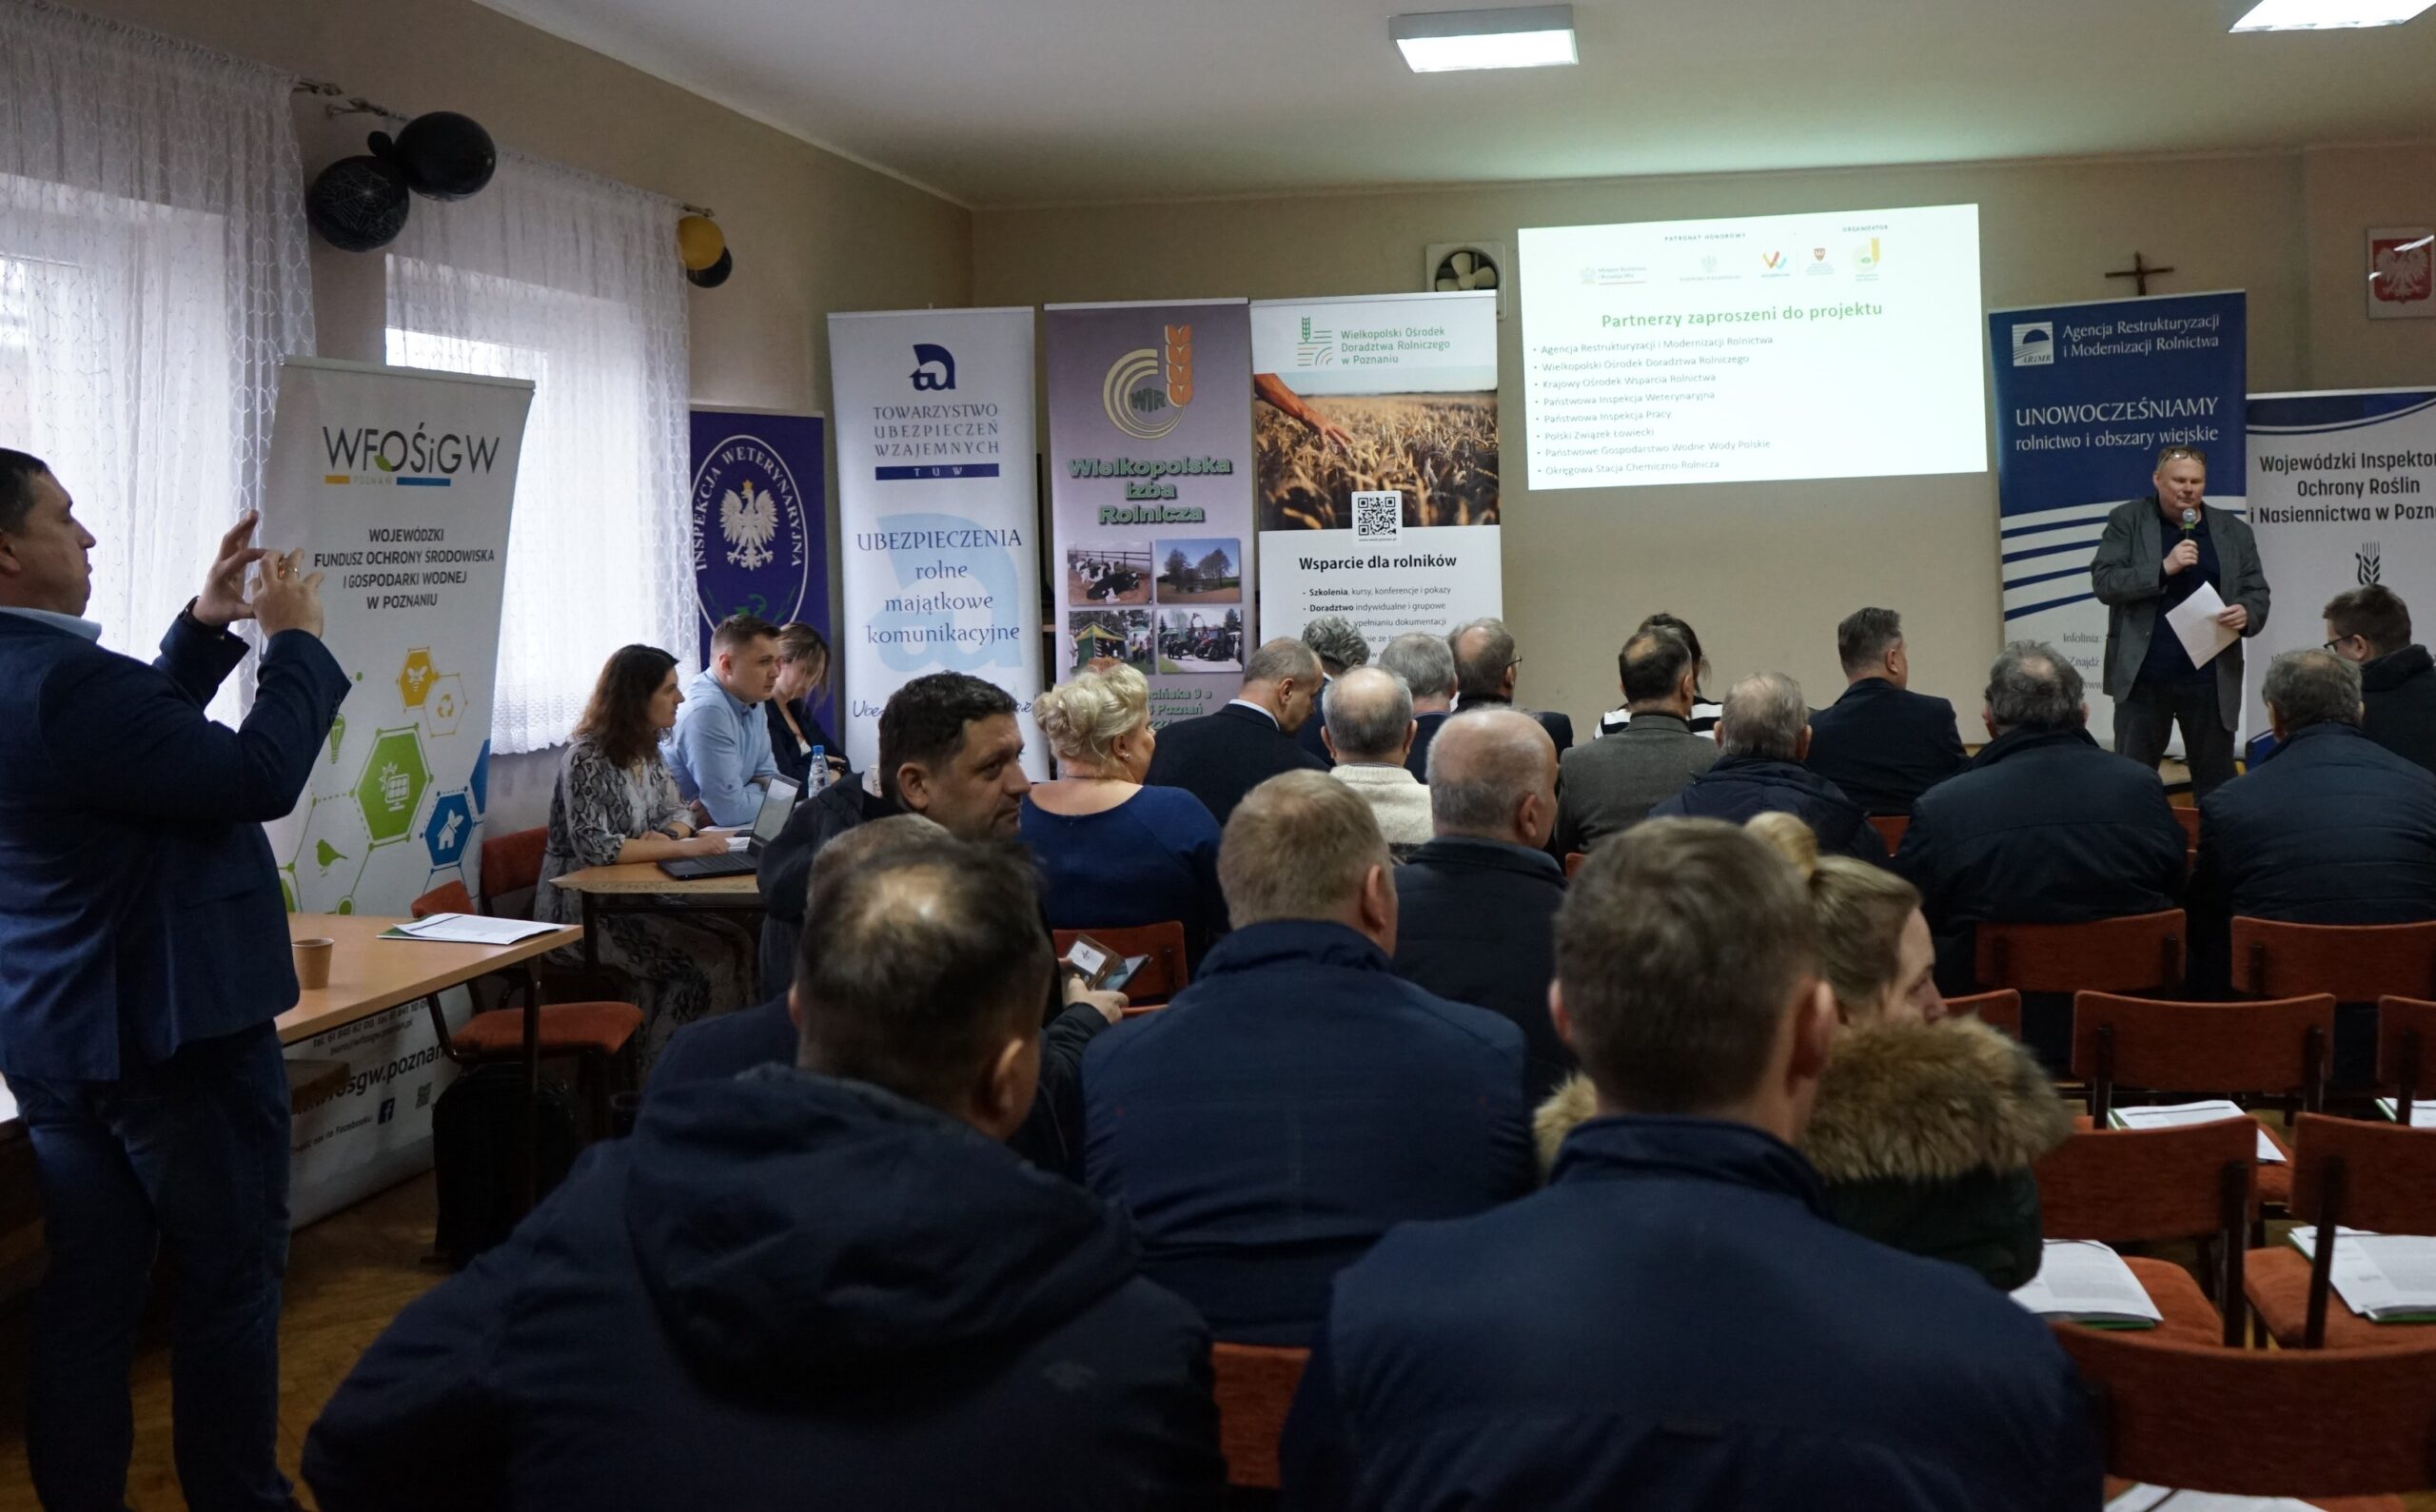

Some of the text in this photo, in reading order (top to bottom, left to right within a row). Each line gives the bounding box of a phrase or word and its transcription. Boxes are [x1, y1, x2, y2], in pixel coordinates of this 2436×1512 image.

[1602, 302, 1882, 330] Partnerzy zaproszeni do projektu
[1341, 327, 1444, 342] Wielkopolski Ośrodek
[2063, 314, 2220, 343] Agencja Restrukturyzacji
[1342, 339, 1450, 352] Doradztwa Rolniczego
[1542, 345, 1578, 356] Agencja
[1581, 341, 1656, 353] Restrukturyzacji
[1663, 338, 1724, 349] Modernizacji
[1727, 336, 1773, 346] Rolnictwa
[2071, 341, 2152, 358] Modernizacji
[2156, 335, 2219, 351] Rolnictwa
[1342, 354, 1399, 365] w Poznaniu
[1542, 356, 1749, 373] Wielkopolski Ośrodek Doradztwa Rolniczego
[1543, 373, 1716, 391] Krajowy Ośrodek Wsparcia Rolnictwa
[1543, 391, 1715, 406] Państwowa Inspekcja Weterynaryjna
[873, 403, 998, 421] TOWARZYSTWO
[1543, 409, 1671, 423] Państwowa Inspekcja Pracy
[2015, 396, 2219, 427] UNOWOCZEŚNIAMY
[874, 419, 998, 440] UBEZPIECZEŃ
[1545, 428, 1654, 441] Polski Związek Łowiecki
[2015, 434, 2081, 451] rolnictwo
[2095, 428, 2154, 450] obszary
[2159, 424, 2219, 445] wiejskie
[874, 442, 999, 459] WZAJEMNYCH
[1545, 439, 1771, 457] Państwowe Gospodarstwo Wodne Wody Polskie
[1068, 455, 1233, 481] Wielkopolska
[1545, 465, 1593, 477] Okręgowa
[1596, 463, 1623, 474] Stacja
[2259, 452, 2356, 476] Wojewódzki
[1125, 481, 1177, 501] Izba
[2297, 476, 2421, 499] Ochrony Roślin
[721, 446, 802, 567] WETERYNARYJNA
[1098, 504, 1205, 525] Rolnicza
[2249, 502, 2436, 523] i Nasiennictwa w Pozn
[693, 466, 722, 571] INSPEKCJA
[369, 525, 443, 542] WOJEWÓDZKI
[856, 529, 1022, 552] UBEZPIECZENIA
[314, 546, 495, 567] FUNDUSZ OCHRONY ŚRODOWISKA
[1299, 554, 1457, 573] Wsparcie dla rolników
[348, 573, 420, 588] GOSPODARKI
[422, 570, 467, 585] WODNEJ
[915, 560, 969, 580] rolne
[1309, 588, 1349, 597] Szkolenia,
[1351, 587, 1374, 597] kursy,
[1374, 586, 1419, 596] konferencje
[1424, 586, 1451, 596] pokazy
[367, 593, 438, 609] W POZNANIU
[885, 592, 993, 616] majątkowe
[1309, 603, 1354, 613] Doradztwo
[1355, 603, 1406, 613] indywidualne
[1412, 601, 1446, 613] grupowe
[1355, 618, 1446, 628] ypełnianiu dokumentacji
[867, 622, 1020, 646] komunikacyjne
[2063, 632, 2102, 644] Infolinia:
[2068, 656, 2100, 669] Znajdź
[1159, 702, 1203, 716] Poznań
